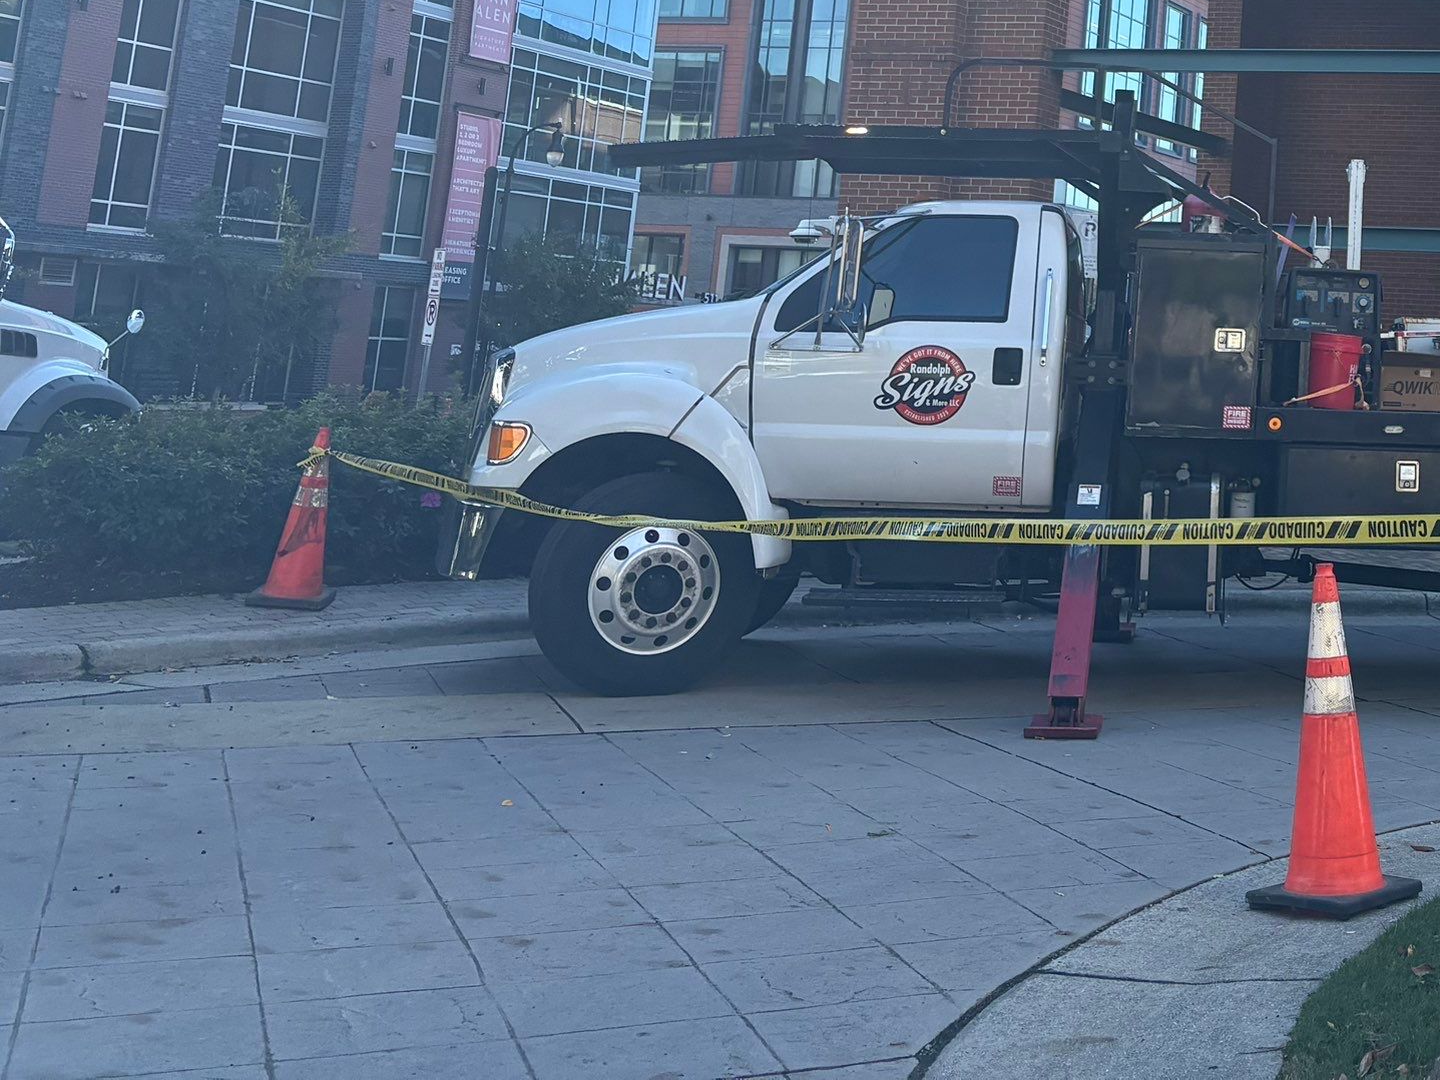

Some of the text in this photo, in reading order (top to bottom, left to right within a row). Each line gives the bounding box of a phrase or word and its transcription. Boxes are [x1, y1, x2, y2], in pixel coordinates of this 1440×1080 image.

[476, 4, 511, 24] ALEN
[444, 266, 467, 276] EASING
[910, 363, 951, 377] Randolph
[875, 372, 974, 408] Signs
[925, 399, 960, 408] & More LLC
[1227, 410, 1247, 418] FIRE
[838, 522, 868, 535] CUIDADO
[889, 522, 924, 536] CAUTION
[947, 522, 987, 537] CUIDADO
[1018, 523, 1063, 539] CAUTION
[1095, 523, 1146, 539] CUIDADO
[1182, 522, 1234, 539] CAUTION
[1269, 522, 1325, 538] CUIDADO
[1368, 520, 1427, 538] CAUTION
